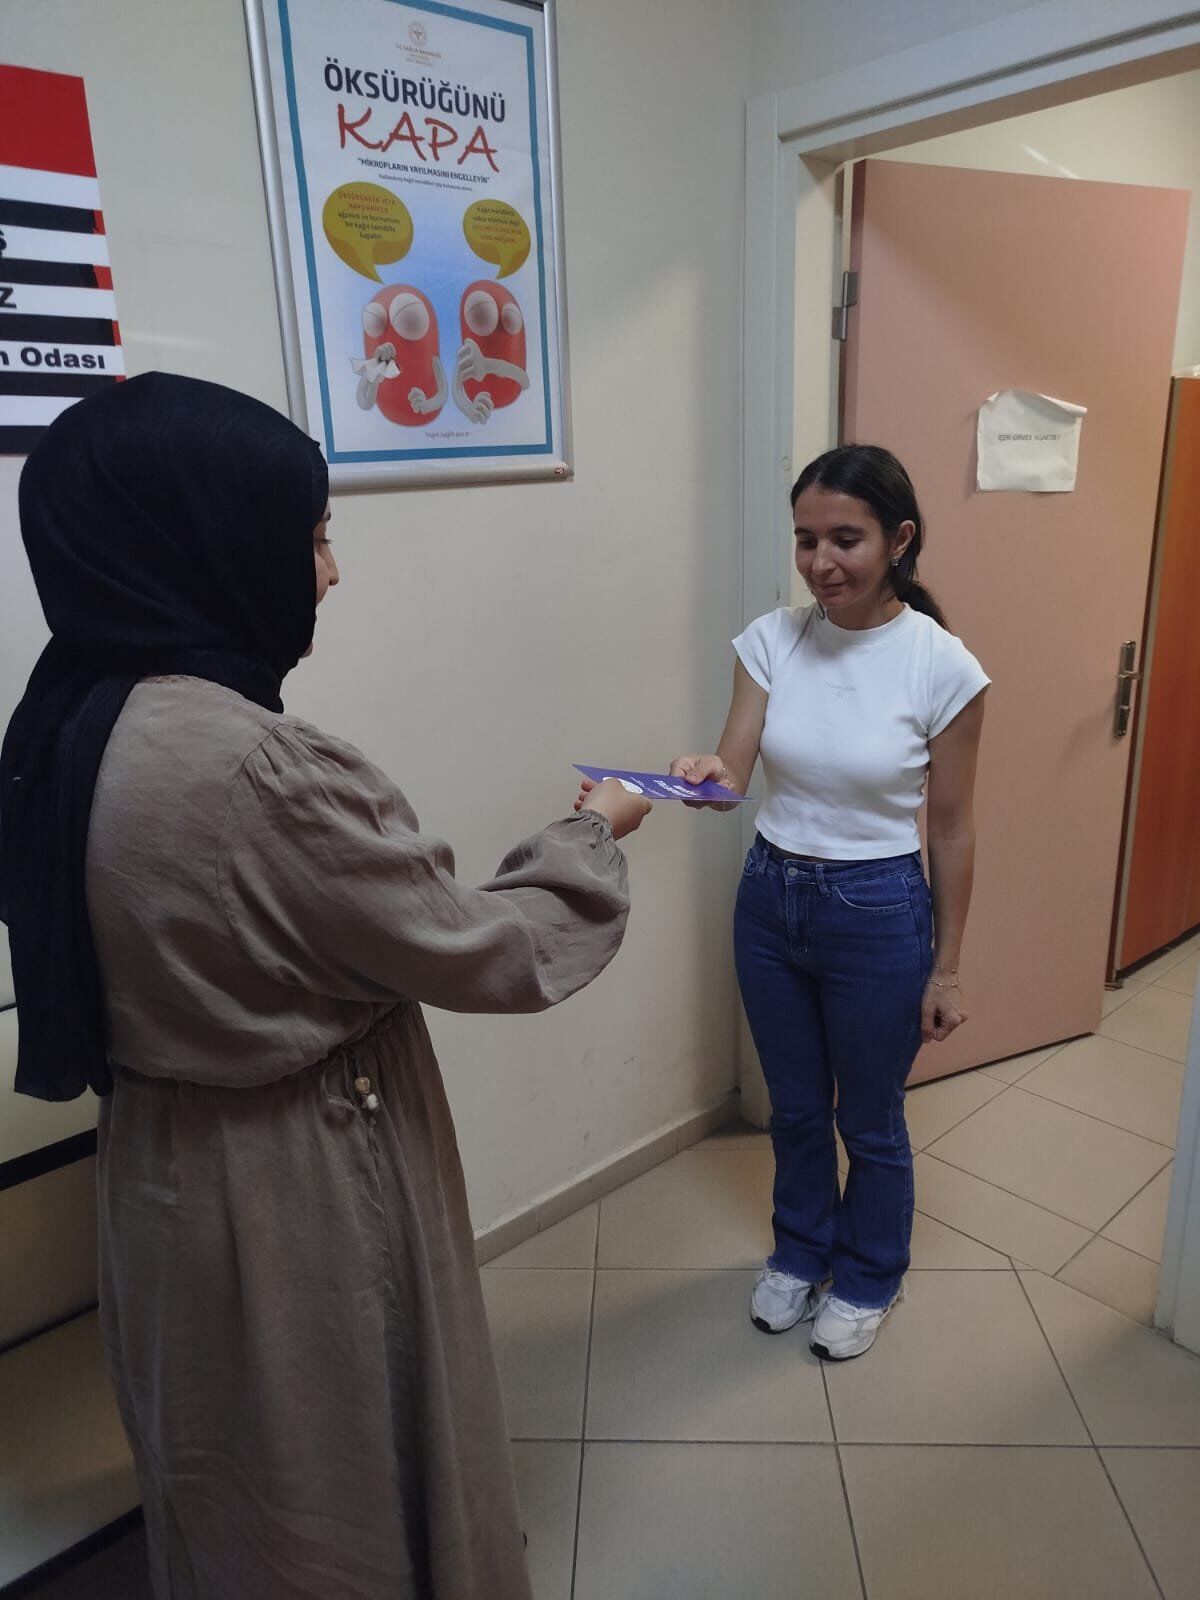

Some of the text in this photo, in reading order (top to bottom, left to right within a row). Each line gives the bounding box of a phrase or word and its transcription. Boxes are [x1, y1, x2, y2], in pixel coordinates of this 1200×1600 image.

[324, 56, 506, 123] ÖKSÜRÜĞÜNÜ
[337, 103, 500, 173] KAPA
[409, 166, 450, 179] YAYILMASINI
[20, 346, 106, 369] Odası
